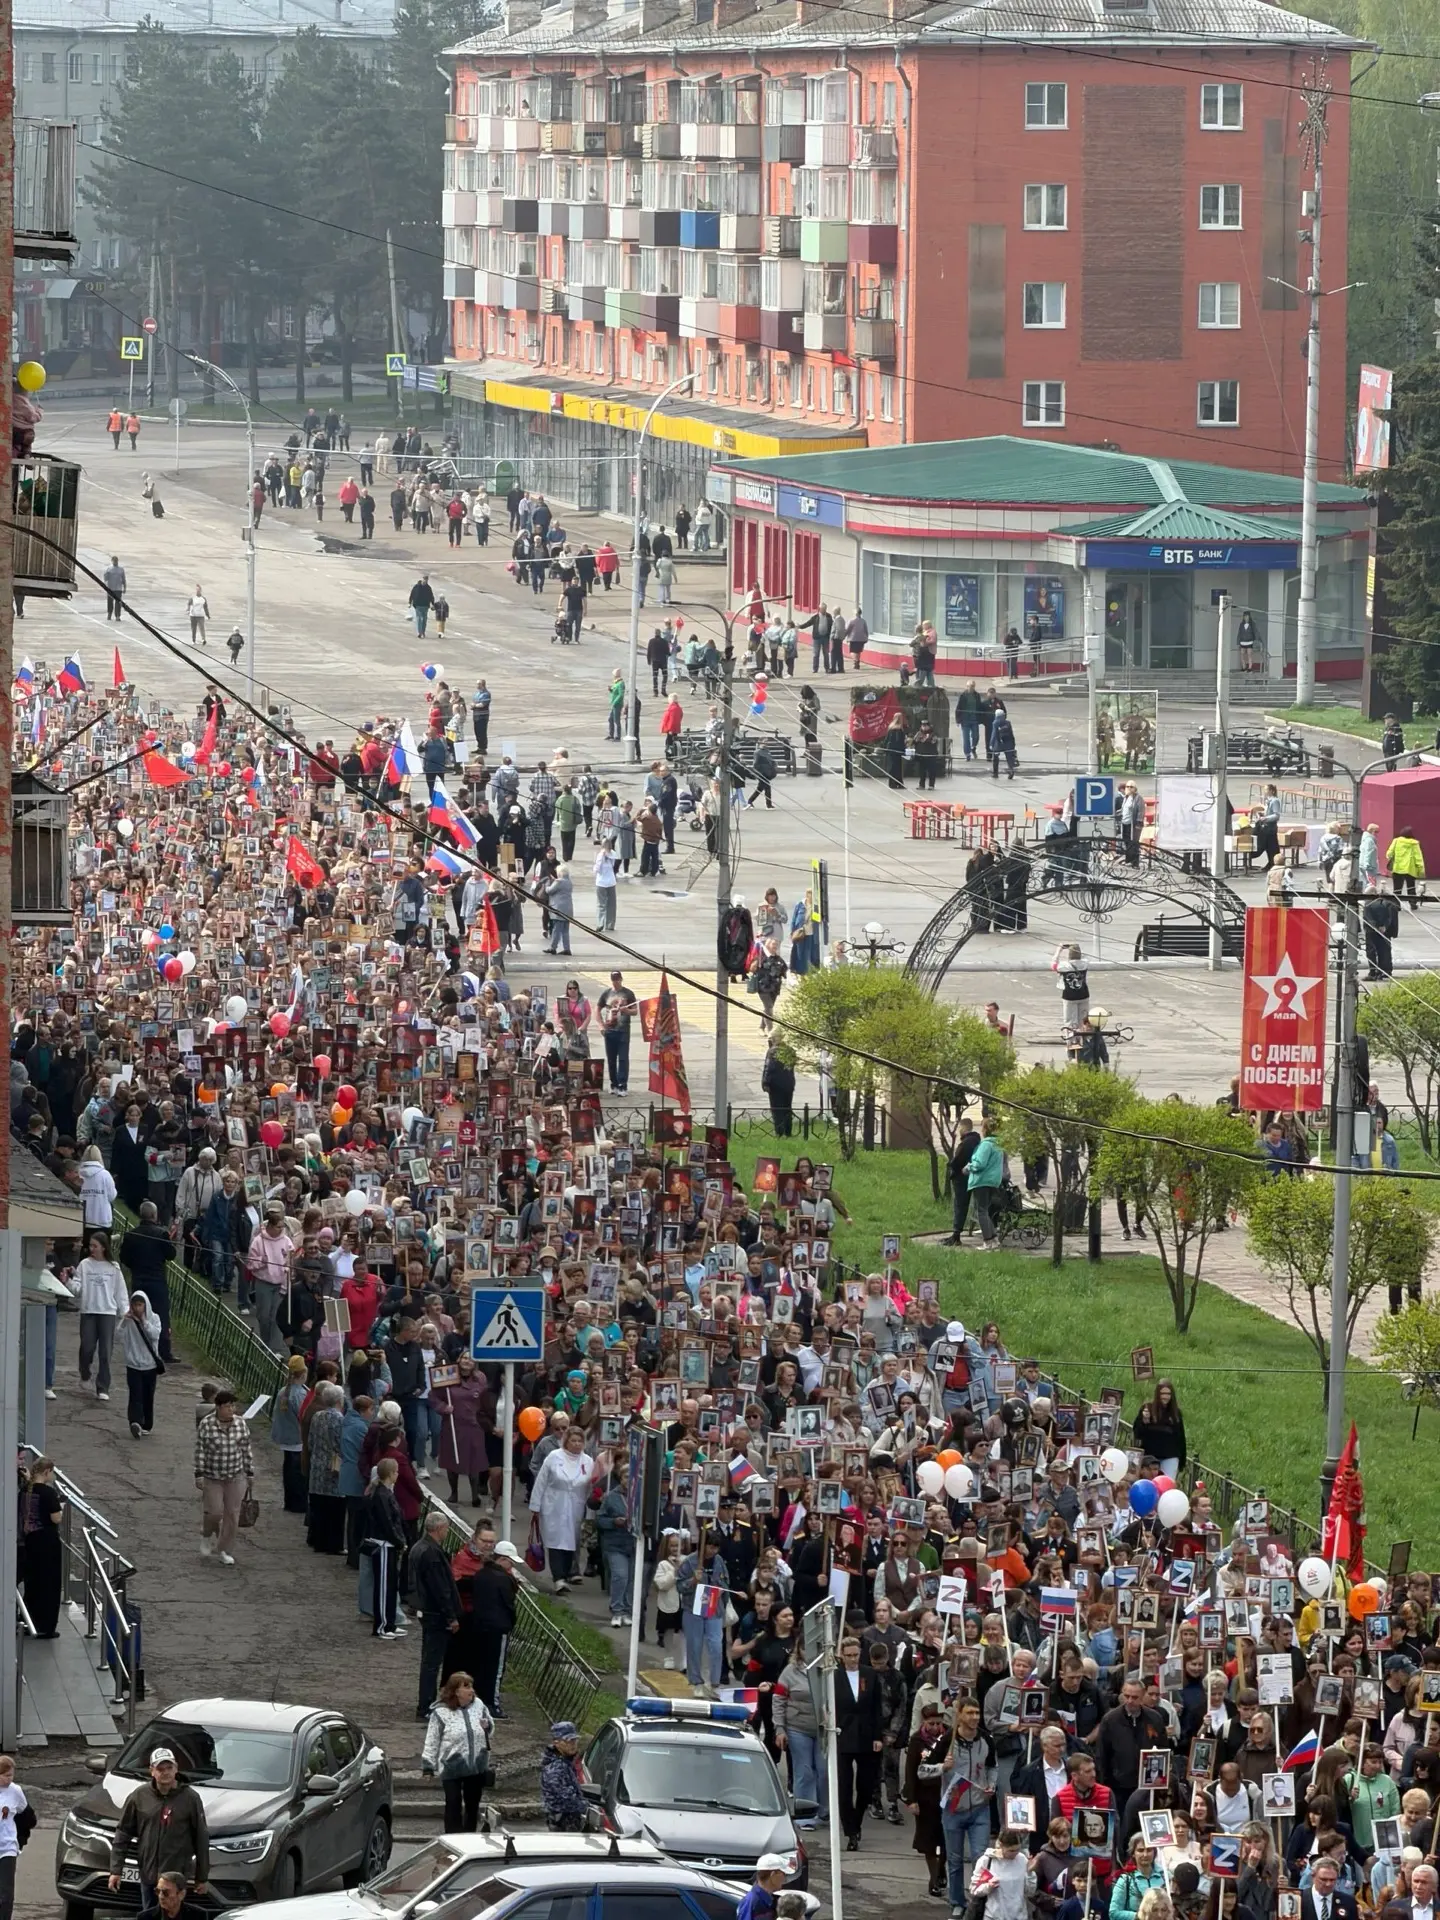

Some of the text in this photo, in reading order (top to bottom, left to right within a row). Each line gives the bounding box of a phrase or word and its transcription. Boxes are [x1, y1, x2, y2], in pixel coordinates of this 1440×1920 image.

[1164, 549, 1223, 564] ВТБ БАНК
[1274, 977, 1297, 1012] 9
[1251, 1044, 1317, 1064] С ДНЕМ
[1244, 1066, 1322, 1087] ПОБЕДЫ!
[1214, 1843, 1238, 1867] Z
